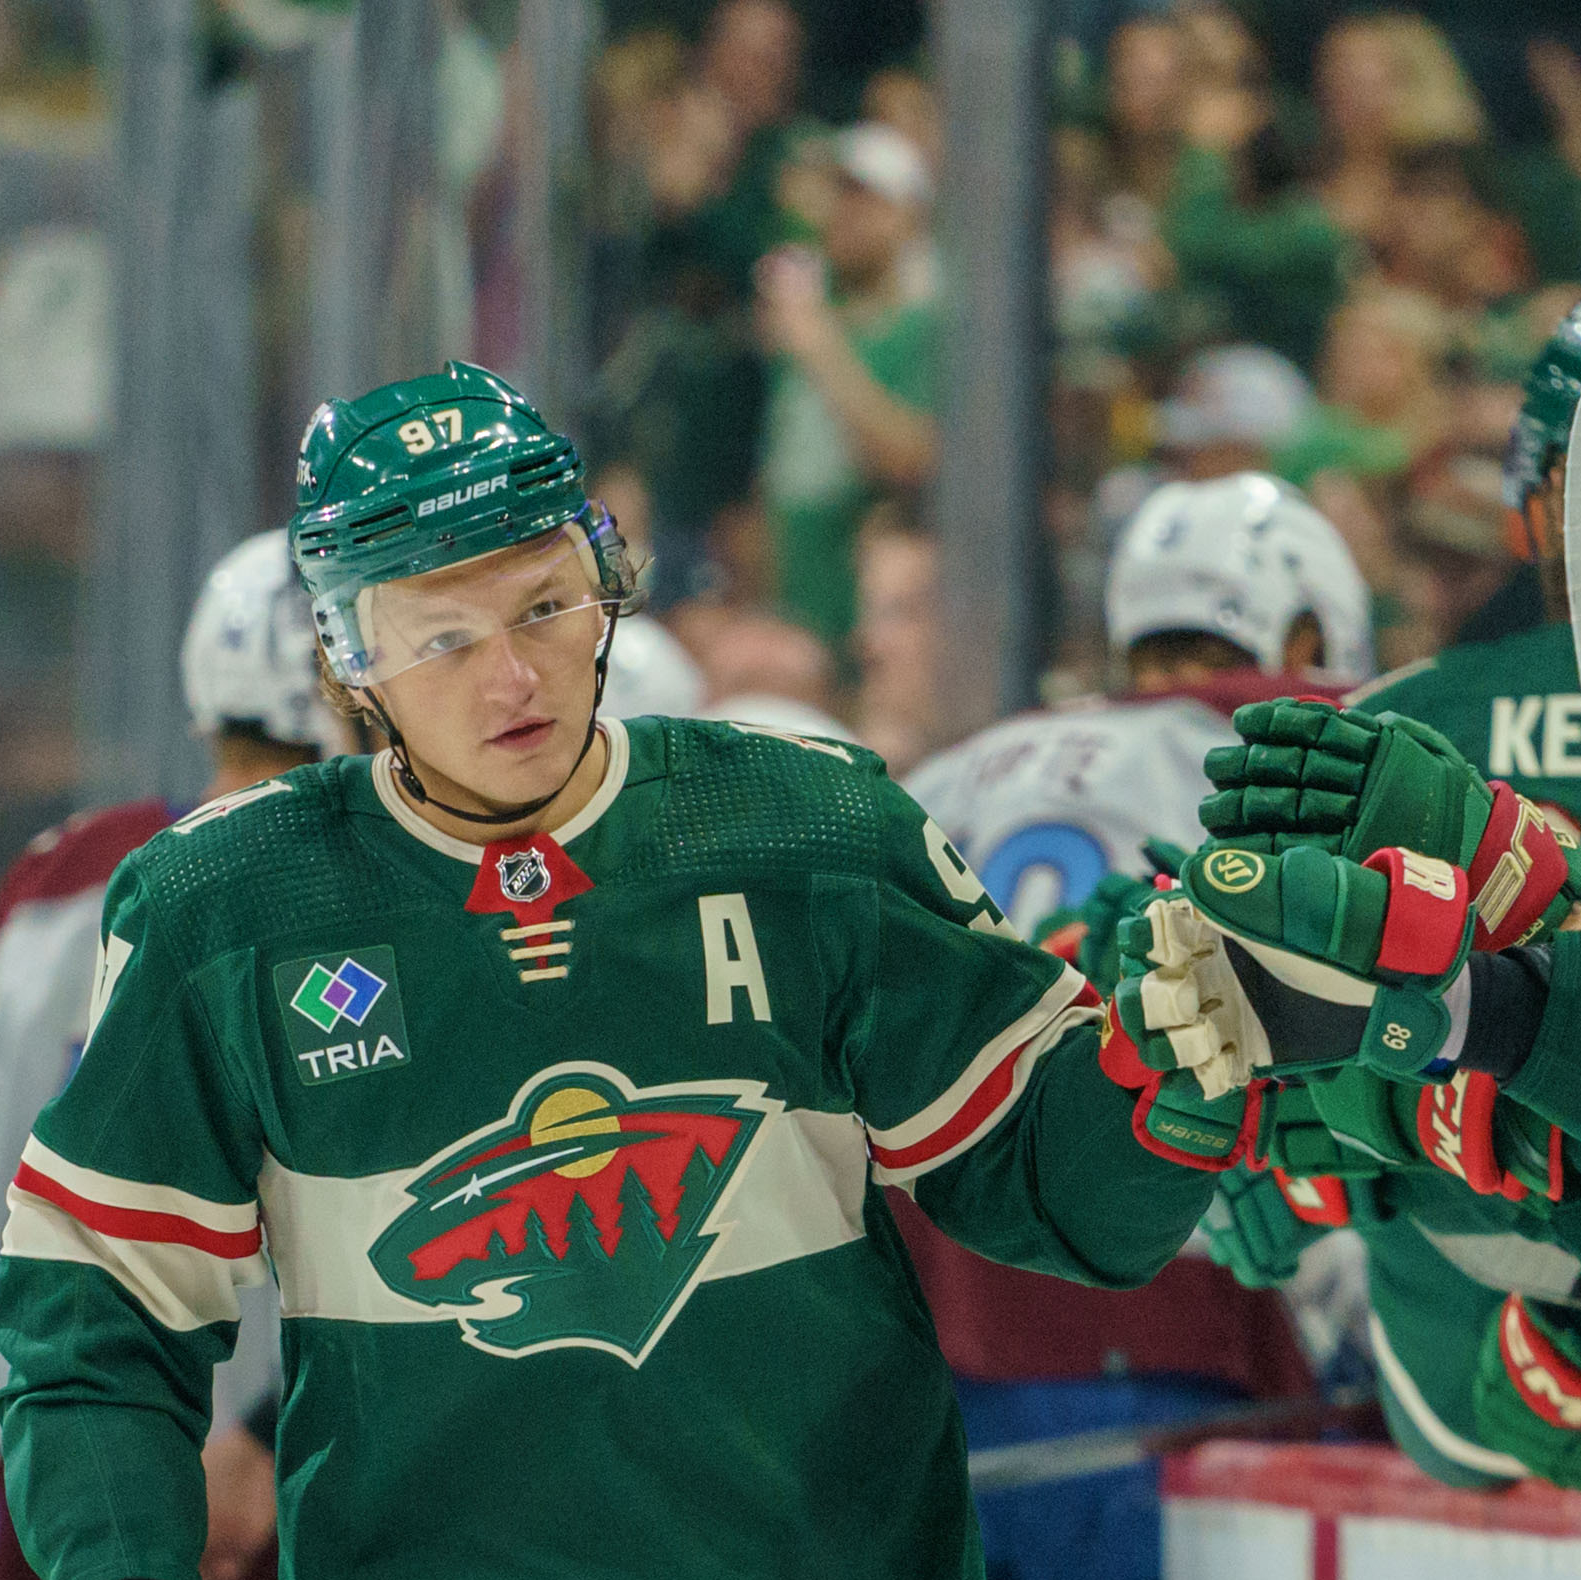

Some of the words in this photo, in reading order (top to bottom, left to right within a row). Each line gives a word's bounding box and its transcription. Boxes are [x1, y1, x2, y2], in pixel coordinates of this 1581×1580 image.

[398, 407, 463, 456] 97
[417, 473, 509, 518] BAUER
[697, 893, 772, 1025] A
[297, 1032, 404, 1080] TRIA
[1382, 1022, 1413, 1051] 89
